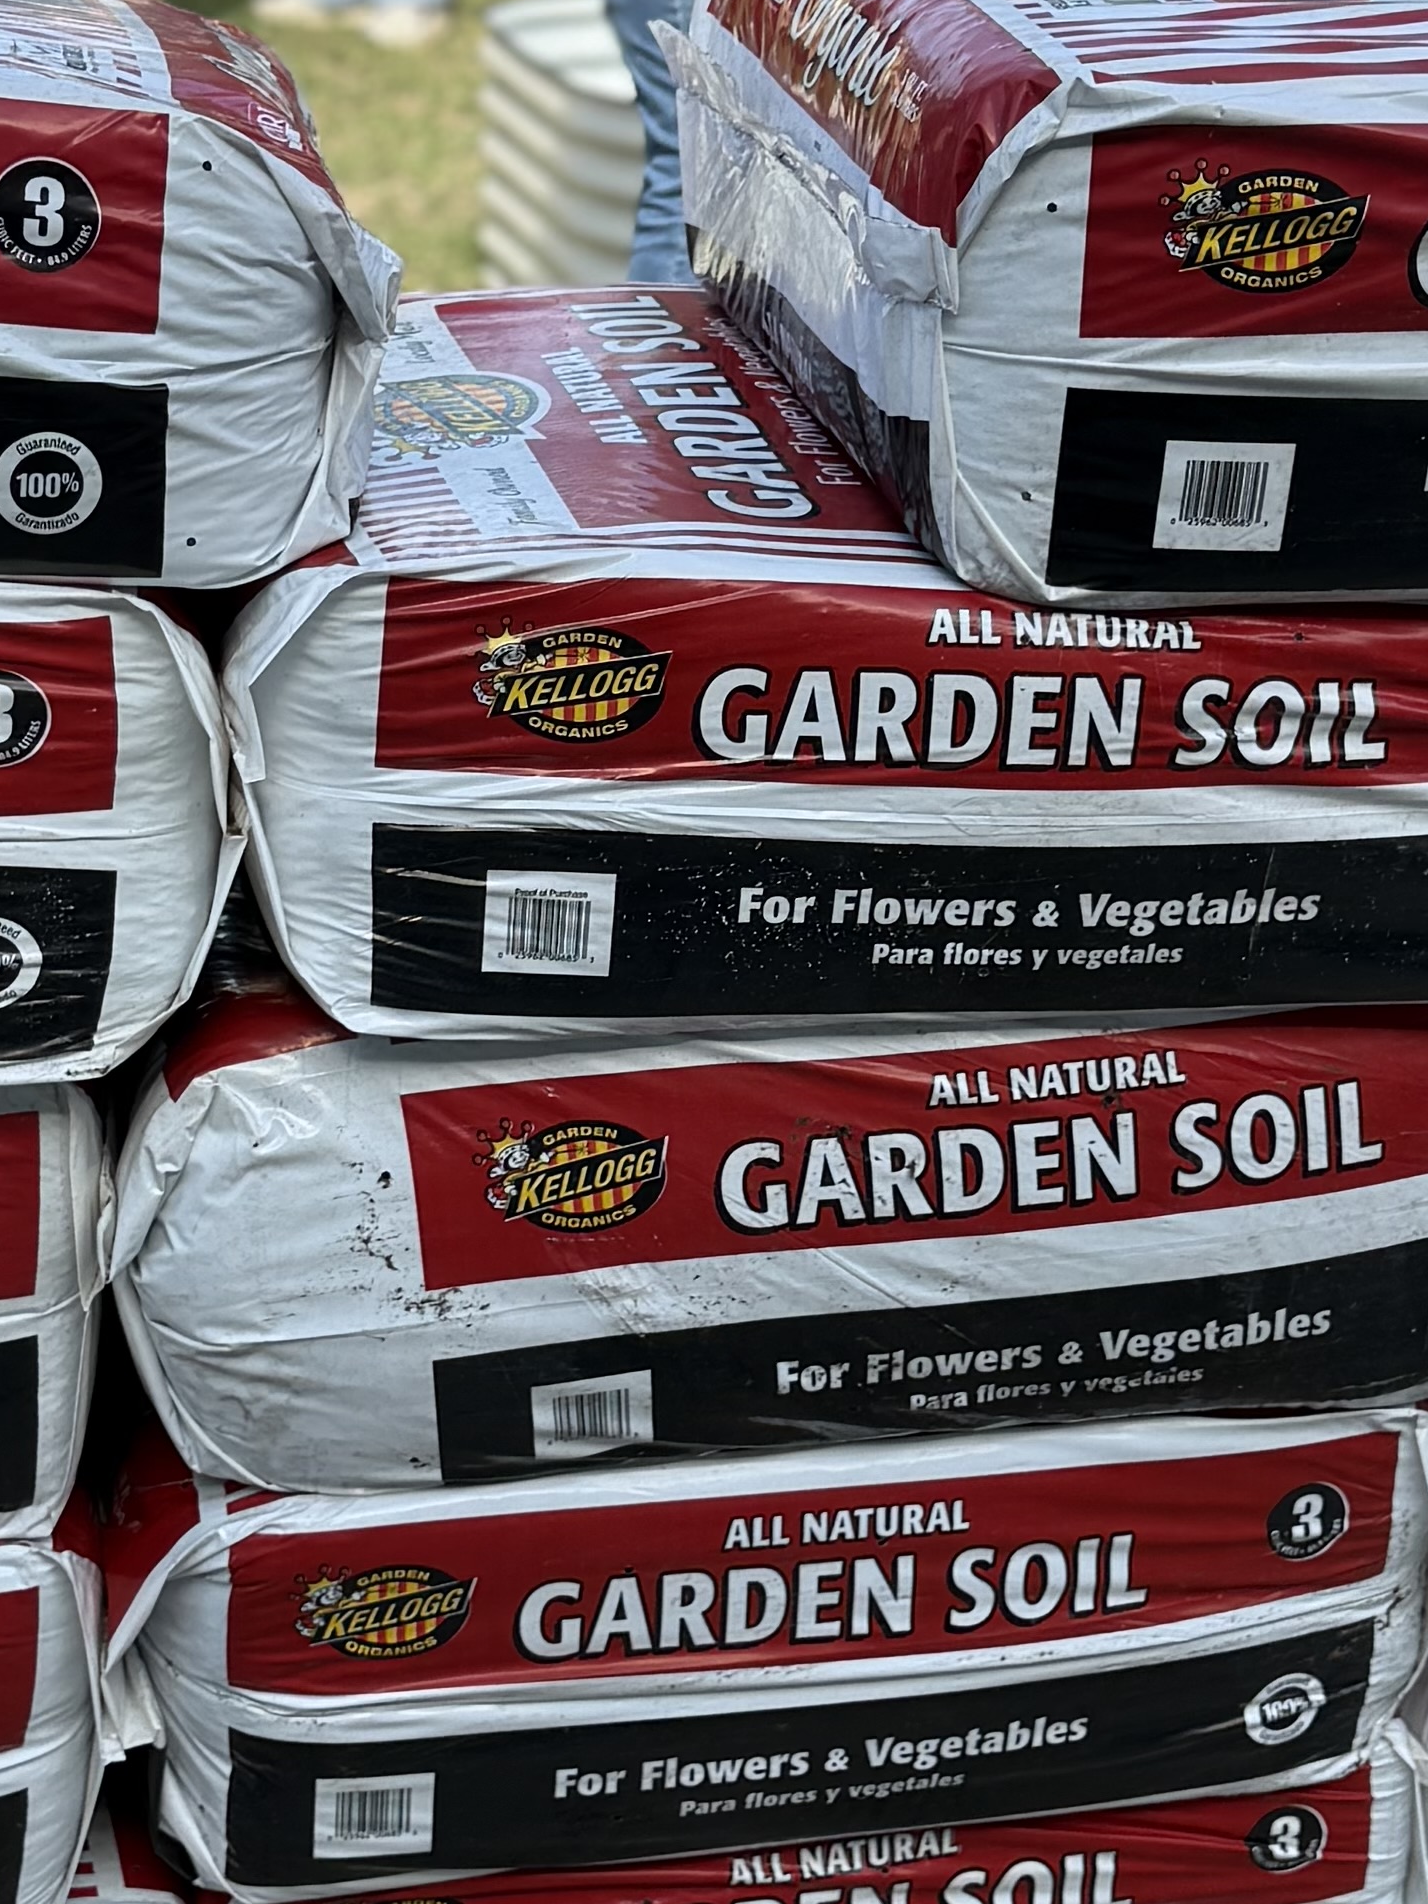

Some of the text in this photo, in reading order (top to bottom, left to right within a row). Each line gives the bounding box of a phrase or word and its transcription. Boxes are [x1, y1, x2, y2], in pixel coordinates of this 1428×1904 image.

[23, 176, 65, 247] 3
[1238, 176, 1319, 195] GARDEN
[1198, 206, 1358, 260] KELLOGG
[1220, 266, 1322, 288] ORGANICS
[572, 296, 813, 519] GARDEN SOIL
[16, 472, 79, 498] 100%
[925, 609, 1201, 651] ALL NATURAL
[503, 662, 658, 714] KELLOGG
[699, 667, 1385, 766] GARDEN SOIL
[738, 888, 1320, 936] For Flowers & Vegetables
[932, 1051, 1185, 1106] ALL NATURAL
[514, 1149, 656, 1212] KELLOGG
[721, 1082, 1382, 1228] GARDEN SOIL
[725, 1500, 969, 1549] ALL NATURAL
[1291, 1492, 1324, 1540] 3
[520, 1535, 1146, 1666] GARDEN SOIL
